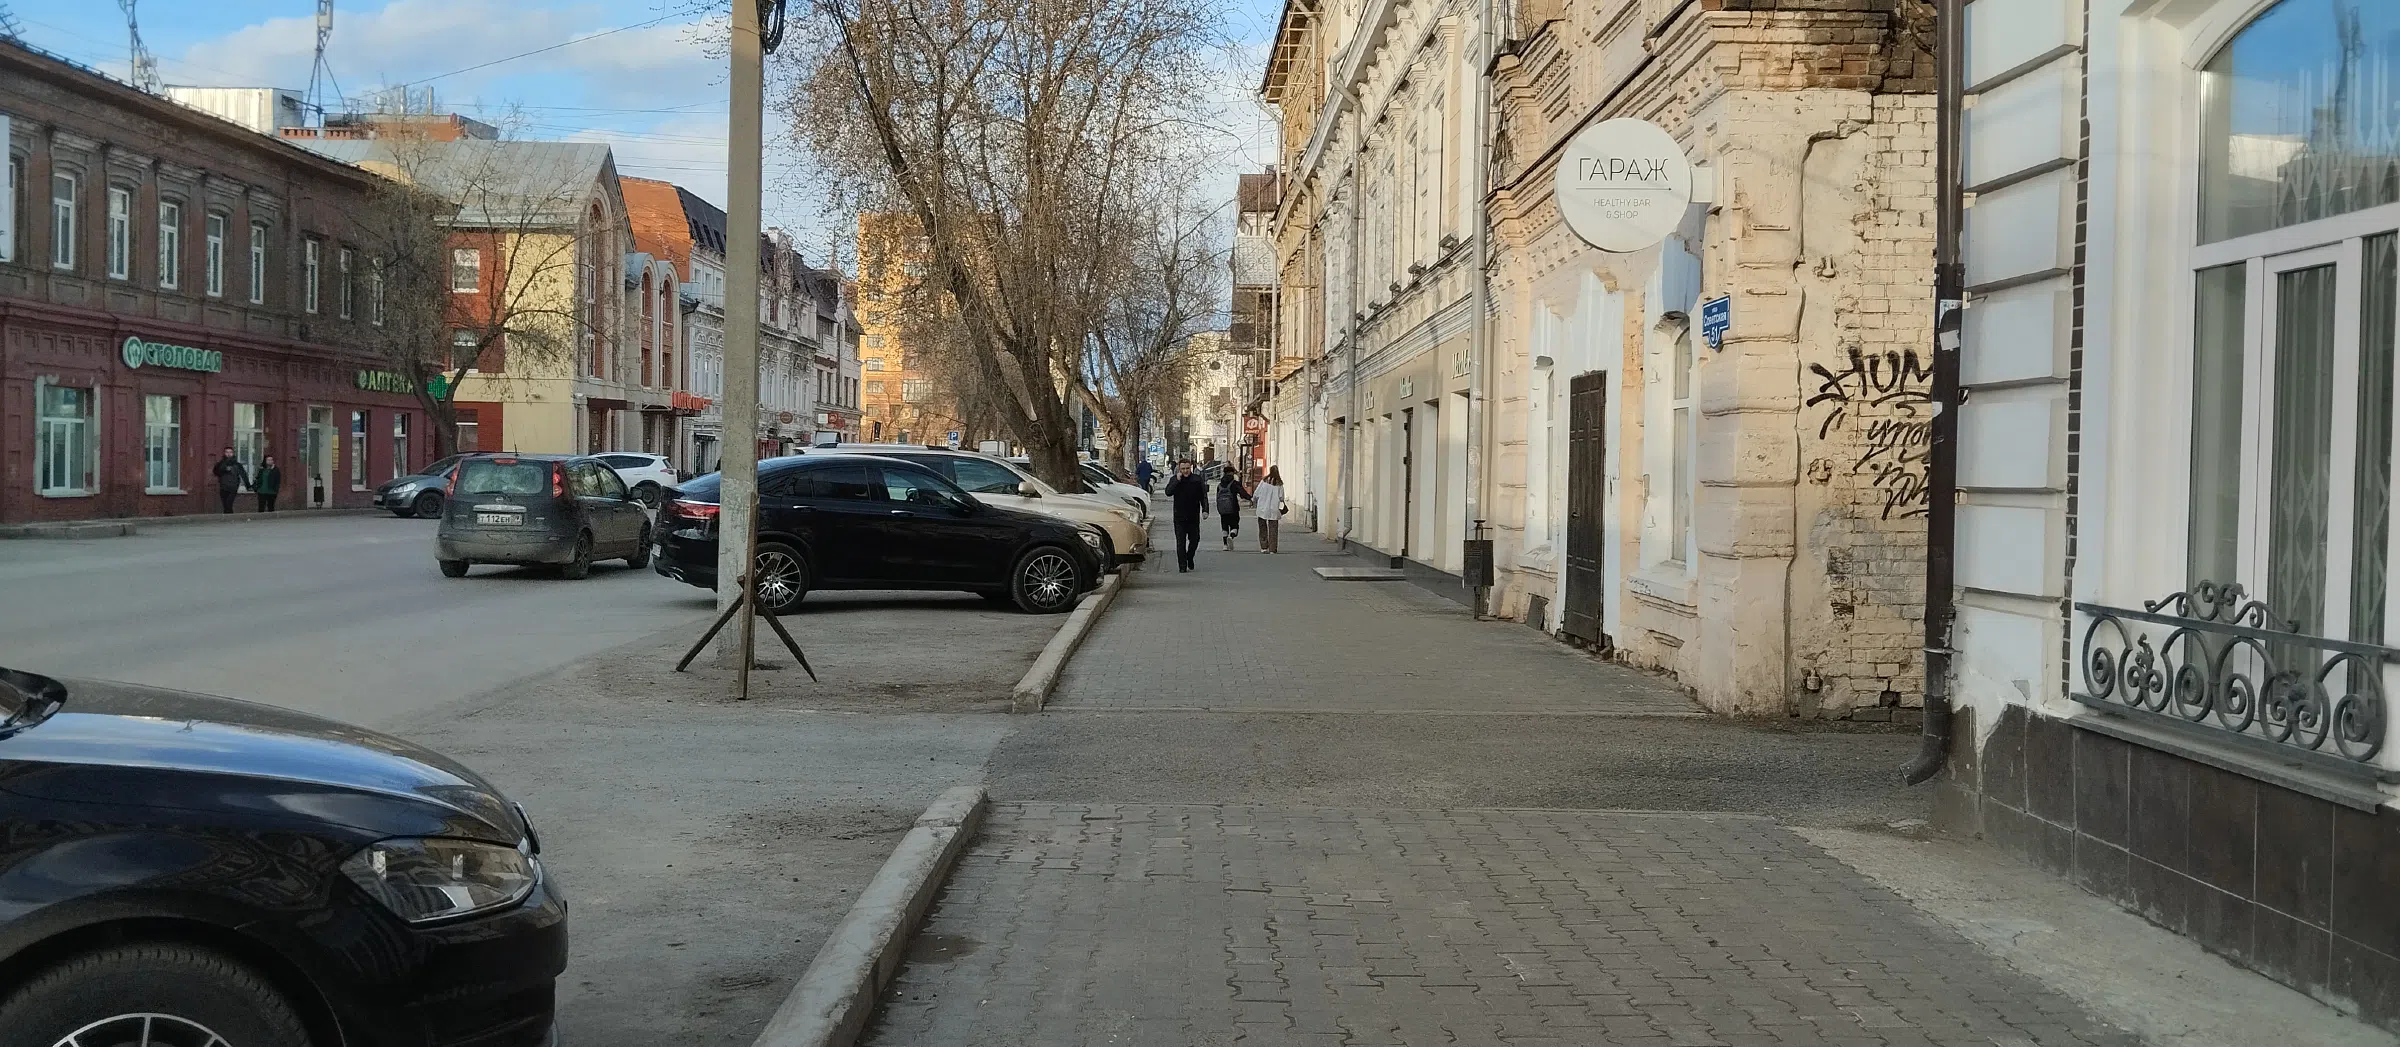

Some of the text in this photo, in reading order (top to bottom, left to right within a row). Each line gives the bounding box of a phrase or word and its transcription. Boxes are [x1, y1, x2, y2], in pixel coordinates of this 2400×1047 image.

[1579, 158, 1669, 181] ГАРАЖ
[1593, 198, 1651, 207] HEALTHY BAR
[1606, 210, 1639, 219] & SHOP
[1711, 325, 1718, 341] 51
[144, 342, 222, 373] СТОЛОВАЯ
[368, 369, 414, 394] АПТЕКА
